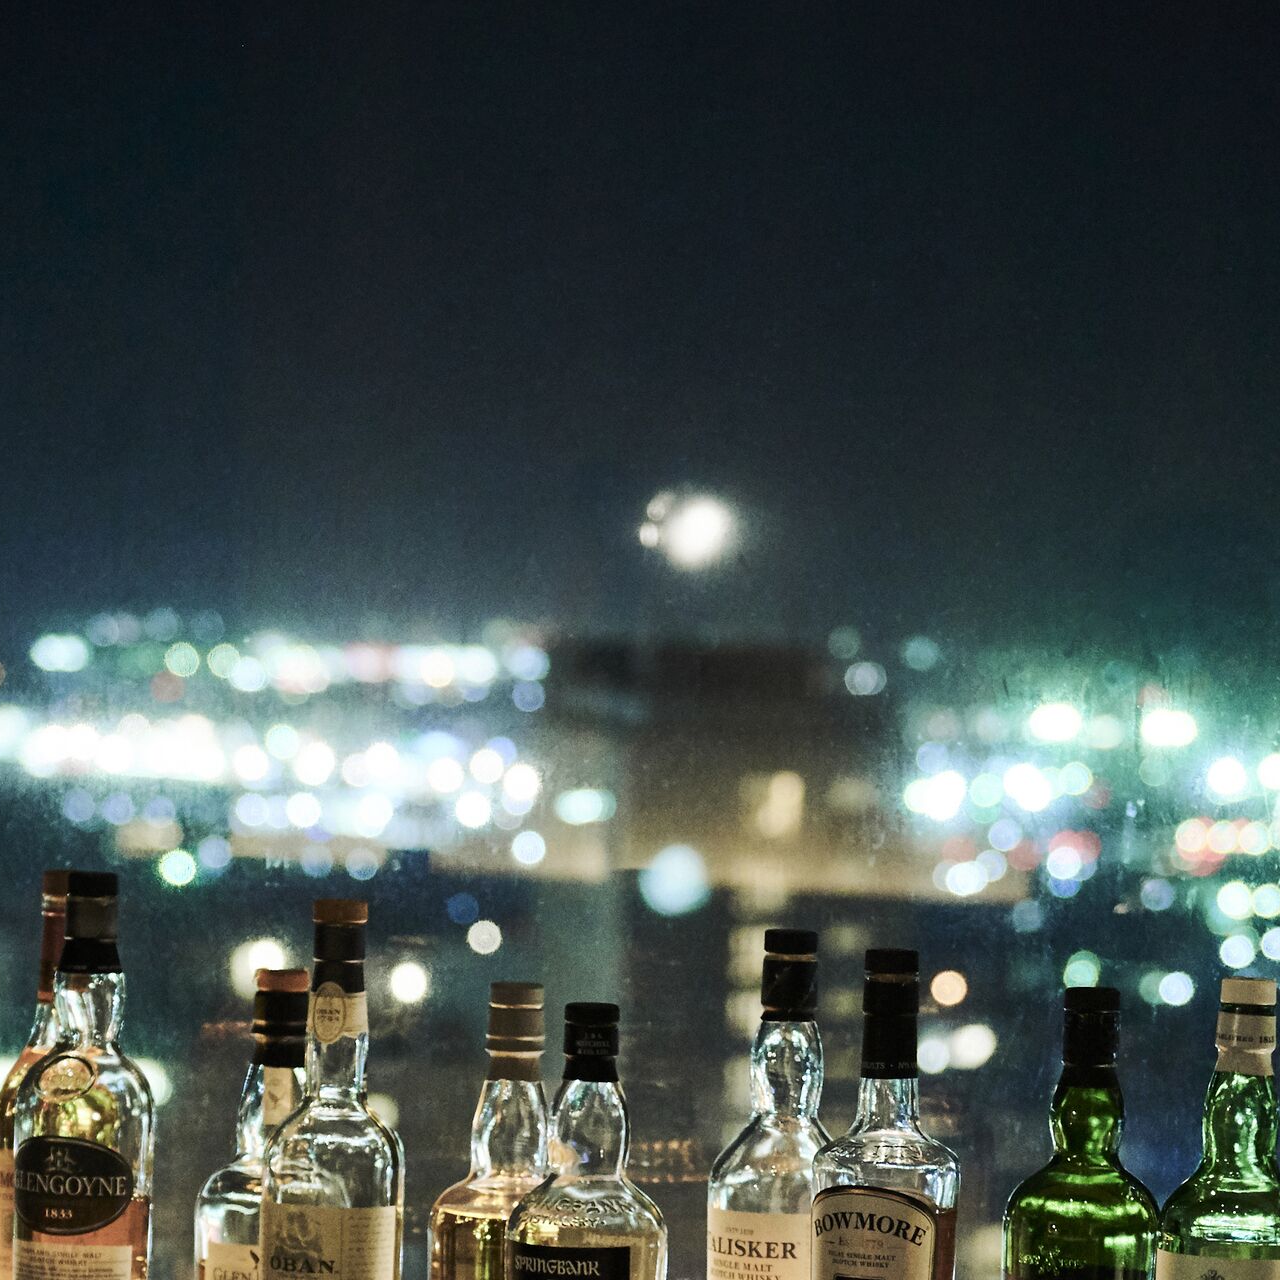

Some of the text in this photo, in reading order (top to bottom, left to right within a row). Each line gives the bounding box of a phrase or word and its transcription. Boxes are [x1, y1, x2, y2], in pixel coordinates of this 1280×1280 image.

[15, 1168, 127, 1197] GLENGOYNE
[814, 1211, 927, 1247] BOWMORE
[270, 1256, 336, 1274] OBAN
[515, 1255, 600, 1277] SPRINGBANK
[831, 1257, 890, 1269] SCOTCH WHISKY
[847, 1252, 872, 1261] SINGLE
[874, 1254, 897, 1262] MALT
[743, 1262, 773, 1272] MALT
